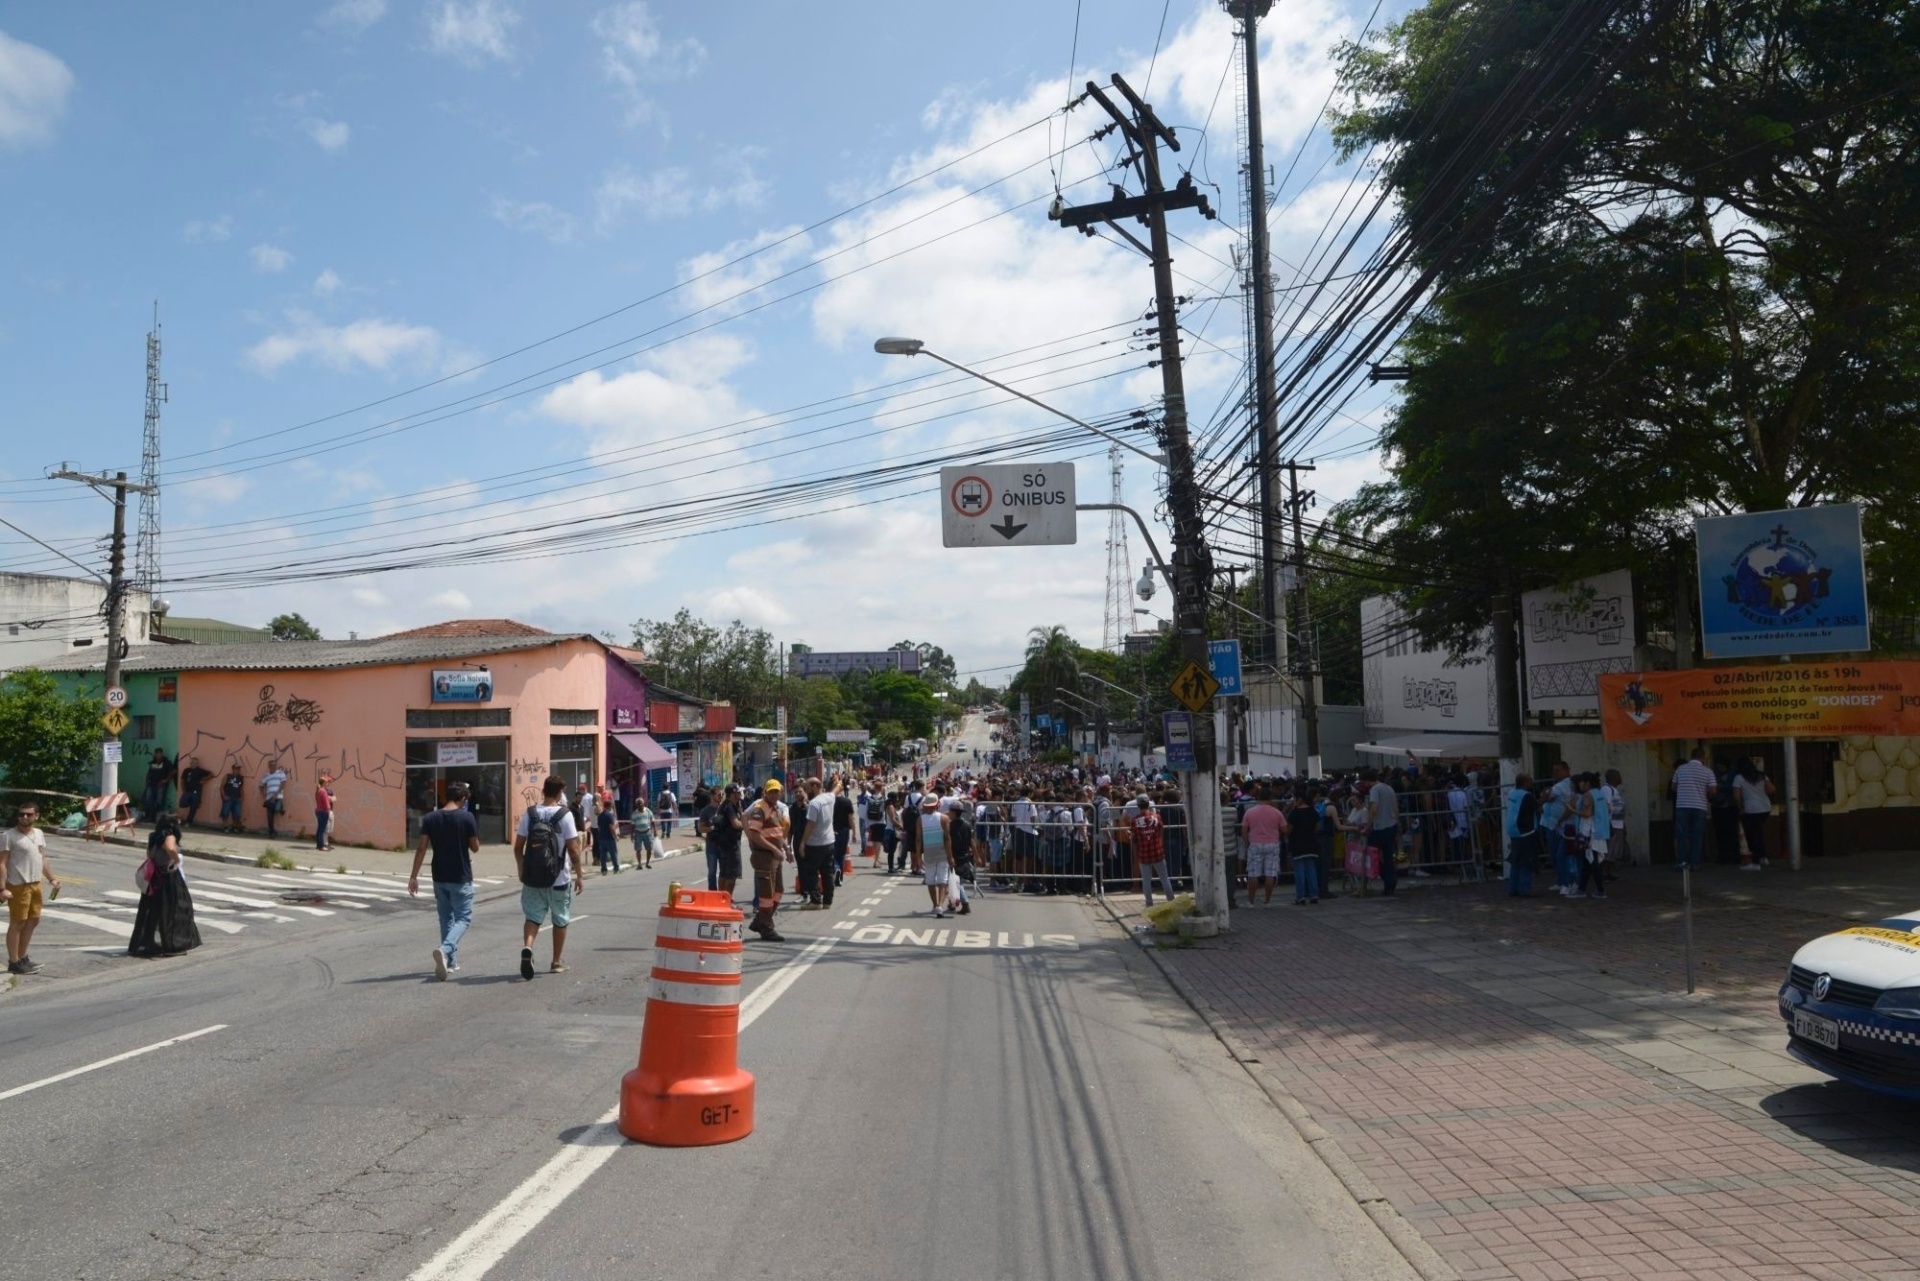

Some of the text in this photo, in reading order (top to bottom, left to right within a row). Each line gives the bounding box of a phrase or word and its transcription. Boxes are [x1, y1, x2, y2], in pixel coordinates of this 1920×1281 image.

[1023, 469, 1046, 488] SÓ
[1002, 489, 1066, 507] ÔNIBUS
[1833, 615, 1858, 625] 385
[1714, 667, 1861, 685] 02/Abril/2016 às 19h
[1766, 686, 1779, 694] da
[1780, 685, 1796, 693] CIA
[1813, 684, 1845, 692] Teatro
[1845, 684, 1876, 692] Jeová
[1878, 683, 1903, 691] Nissi
[109, 692, 124, 701] 20
[1702, 700, 1728, 710] com
[1731, 701, 1739, 709] o
[1742, 696, 1807, 709] monólogo
[1761, 711, 1820, 721] Não perca!
[1763, 724, 1775, 732] de
[1820, 723, 1839, 731] não
[848, 924, 1080, 951] ÔNIBUS
